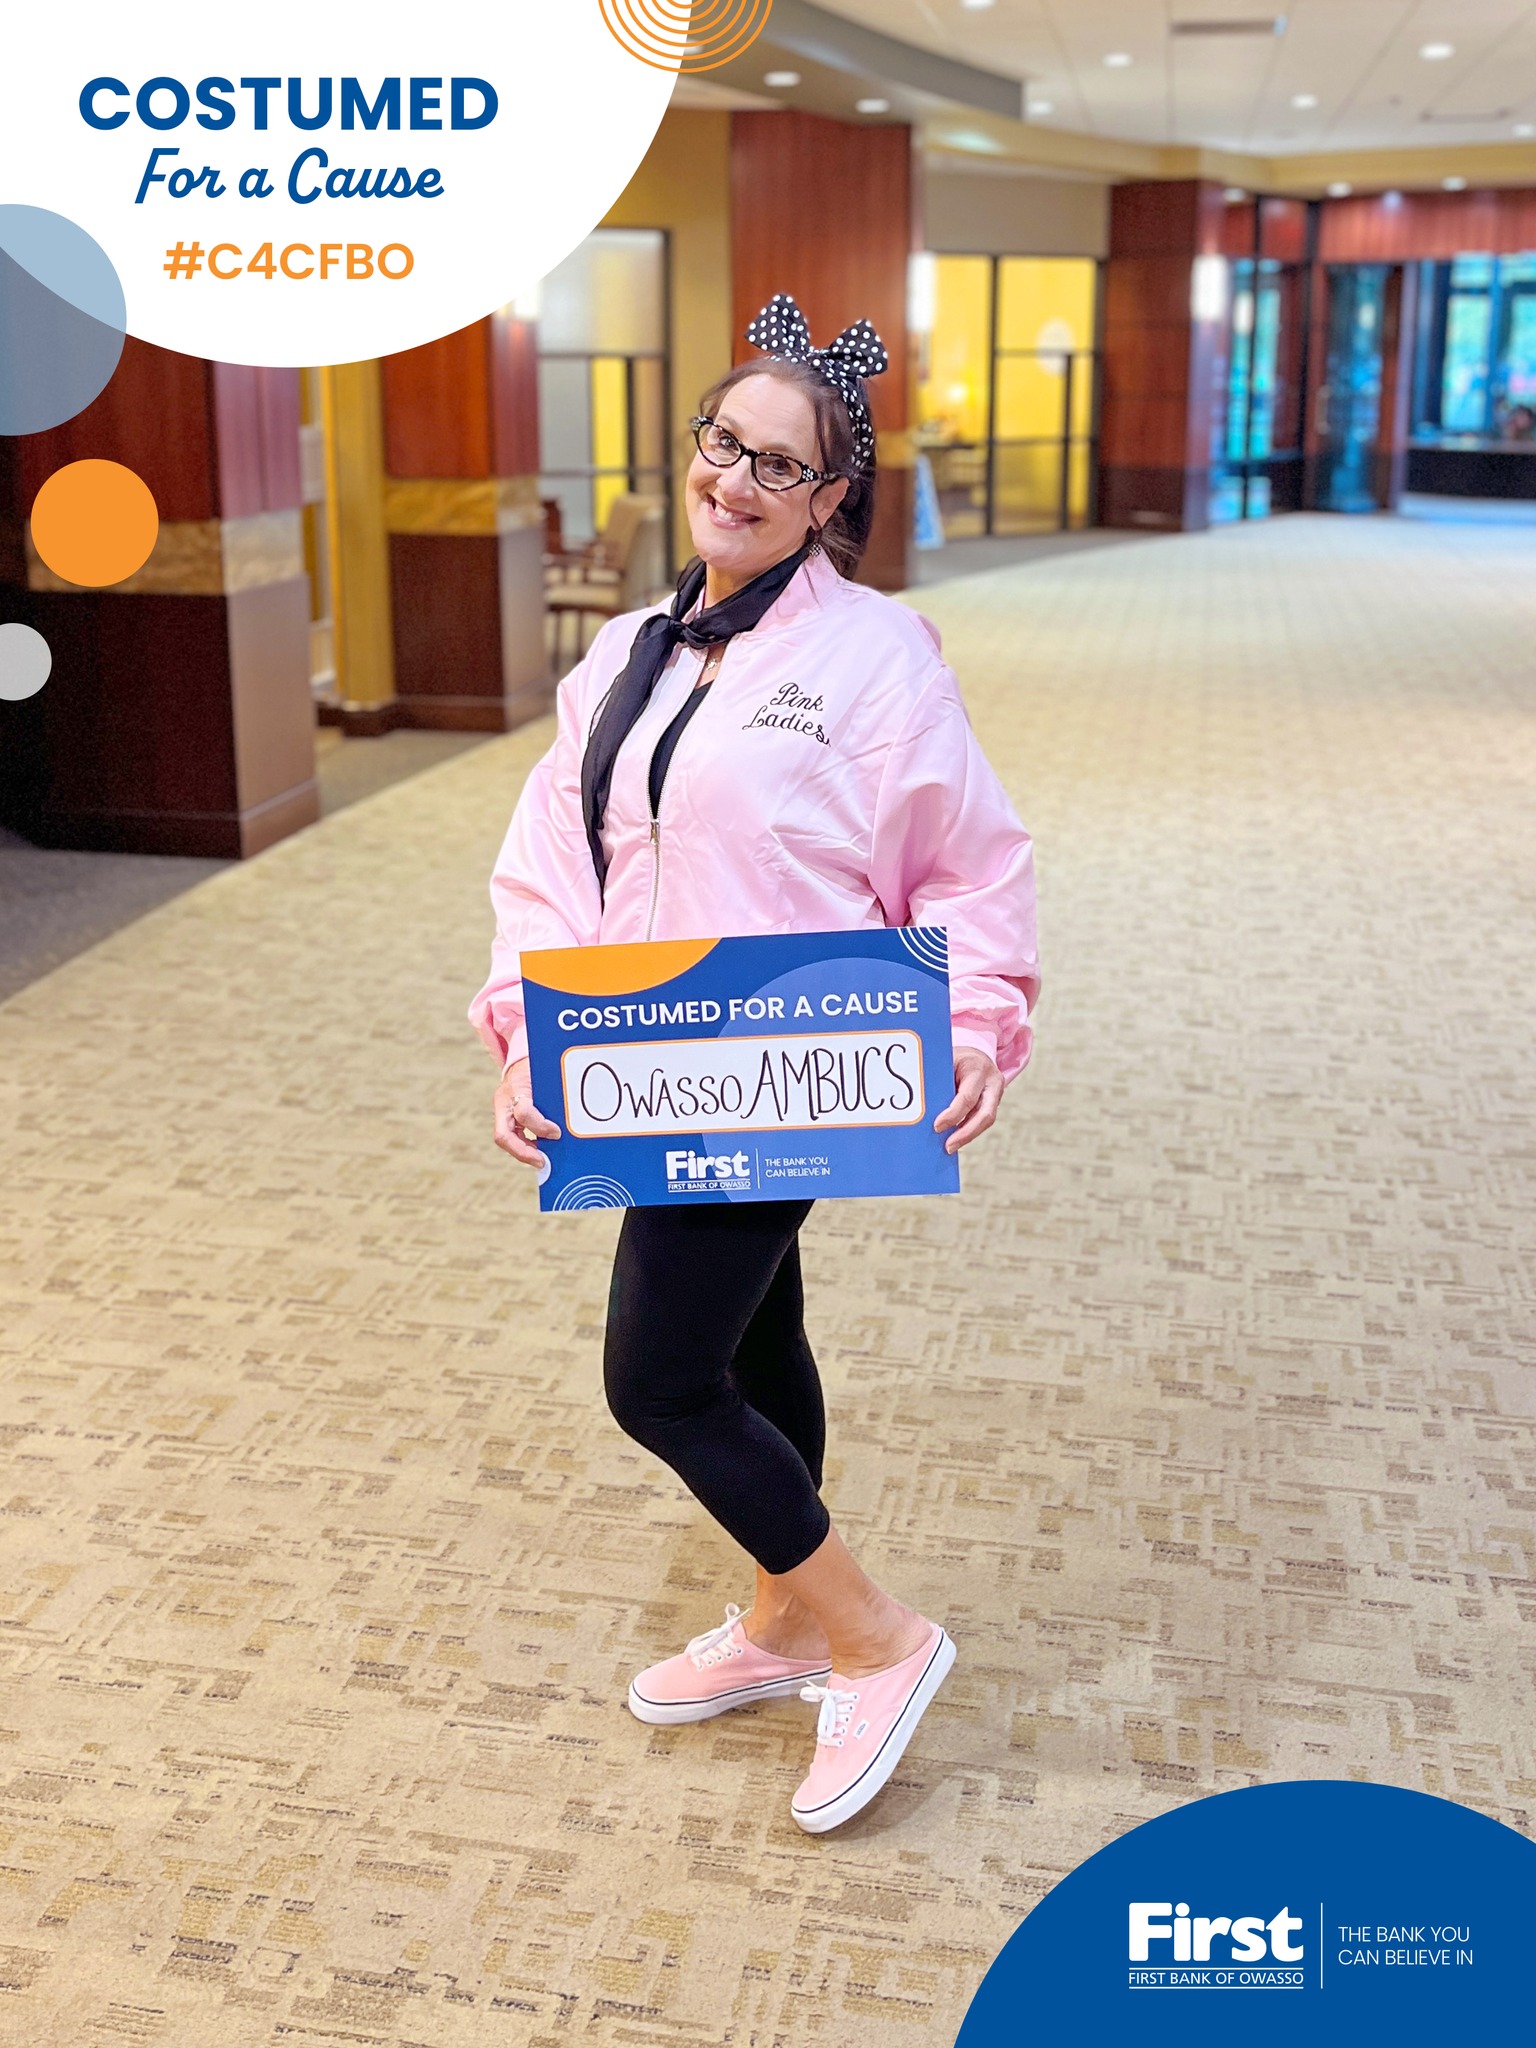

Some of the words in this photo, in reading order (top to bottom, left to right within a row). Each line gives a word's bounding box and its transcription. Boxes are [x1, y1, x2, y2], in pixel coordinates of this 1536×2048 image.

[769, 682, 824, 712] Pink
[742, 705, 832, 747] Ladies
[557, 1000, 721, 1031] COSTUMED
[728, 993, 785, 1021] FOR
[793, 995, 814, 1018] A
[821, 990, 919, 1016] CAUSE
[740, 1043, 914, 1121] AMBUCS
[665, 1150, 750, 1180] First
[765, 1158, 781, 1167] THE
[783, 1157, 807, 1166] BANK
[808, 1156, 829, 1166] YOU
[765, 1169, 786, 1178] CAN
[788, 1168, 820, 1177] BELIEVE
[821, 1167, 831, 1176] IN
[668, 1183, 687, 1191] FIRST
[687, 1182, 707, 1190] BANK
[708, 1181, 719, 1189] OF
[719, 1180, 751, 1188] OWASSO
